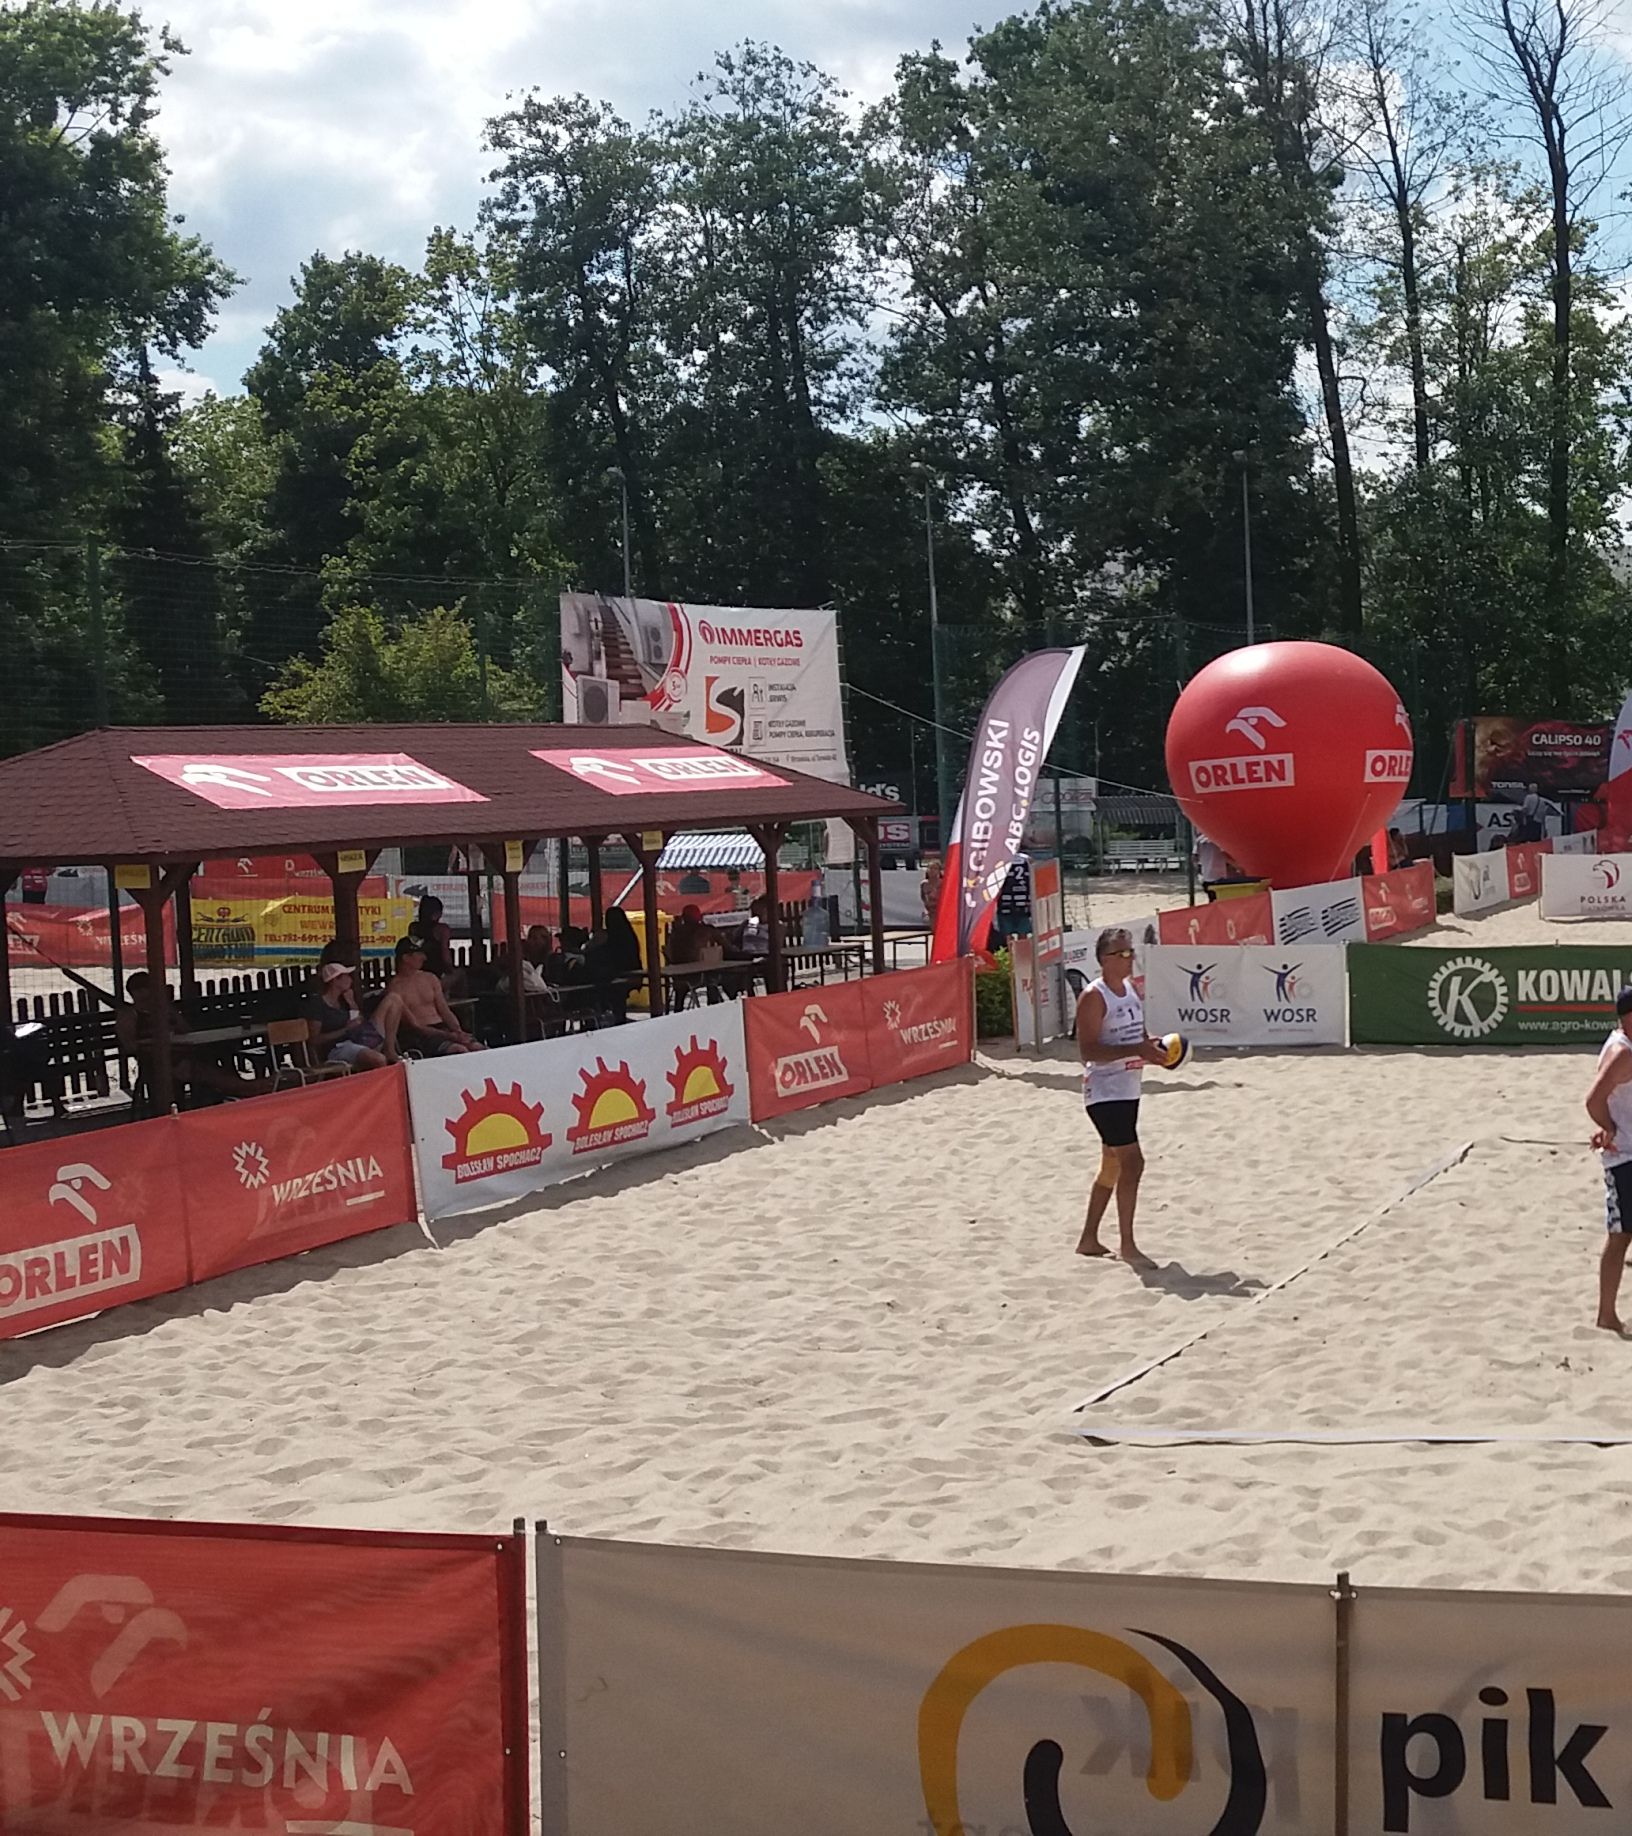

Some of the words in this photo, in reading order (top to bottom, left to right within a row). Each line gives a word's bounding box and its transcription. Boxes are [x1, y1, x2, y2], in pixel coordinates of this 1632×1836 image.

[716, 627, 803, 648] IMMERGAS
[1531, 733, 1582, 746] CALIPSO
[1584, 734, 1602, 746] 40
[296, 766, 432, 787] ORLEN
[646, 759, 753, 777] ORLEN
[1194, 758, 1286, 788] ORLEN
[969, 717, 1010, 873] GIBOWSKI
[282, 905, 329, 915] CENTRUM
[1580, 895, 1626, 904] POLSKA
[1178, 1008, 1230, 1023] WOSR
[1263, 1008, 1317, 1023] WOSR
[780, 1052, 843, 1089] ORLEN
[456, 1159, 495, 1180] BOLESŁAW
[496, 1147, 542, 1170] SPOCHACZ
[272, 1154, 384, 1208] WRZEŚNIA
[0, 1233, 132, 1309] ORLEN
[39, 1706, 415, 1796] WRZEŚNIA
[1381, 1684, 1614, 1833] pik
